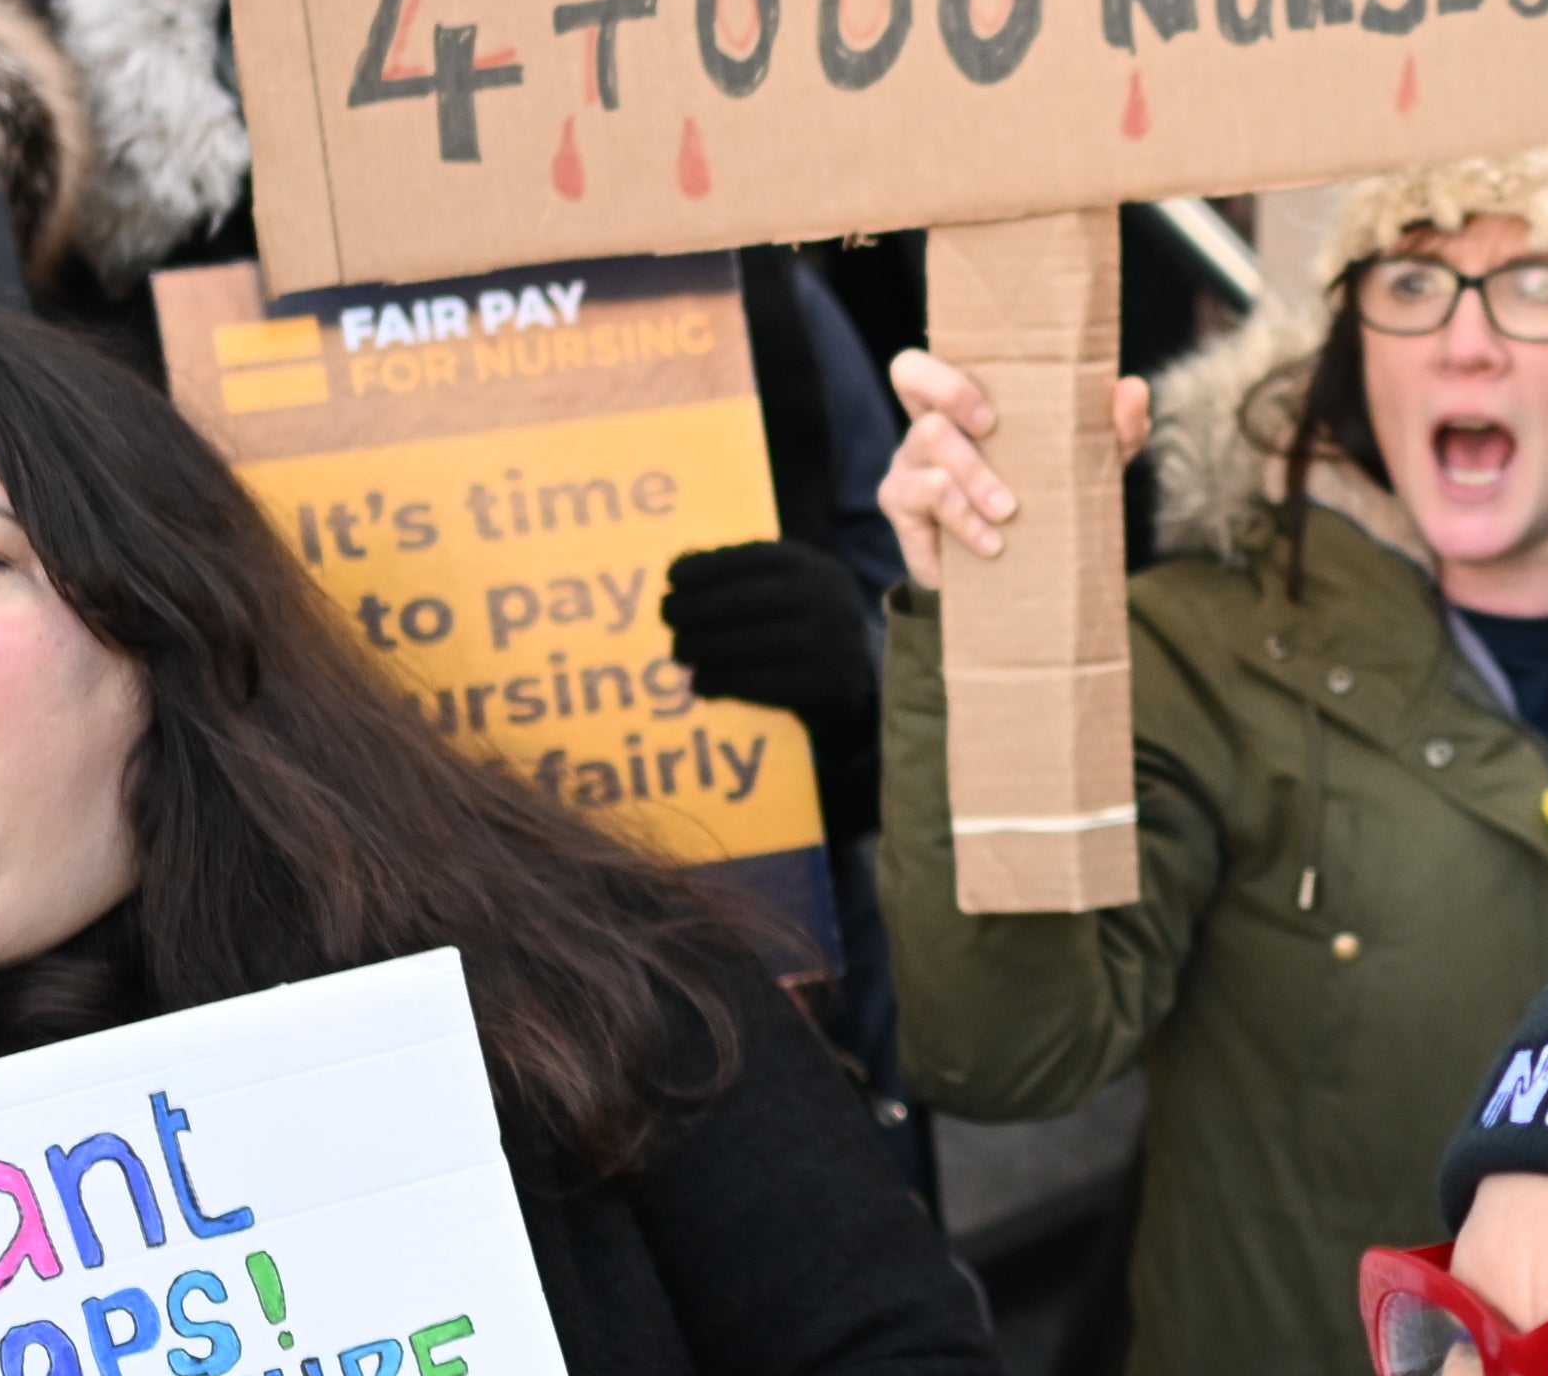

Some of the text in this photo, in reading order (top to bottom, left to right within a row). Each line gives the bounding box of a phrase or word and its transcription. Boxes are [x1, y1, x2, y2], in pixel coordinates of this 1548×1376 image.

[339, 278, 587, 354] FAIR PAY
[349, 310, 718, 399] FOR NURSING
[297, 468, 679, 567] It's time
[355, 564, 648, 654] to pay
[400, 651, 697, 738] ursing
[537, 728, 770, 812] fairly
